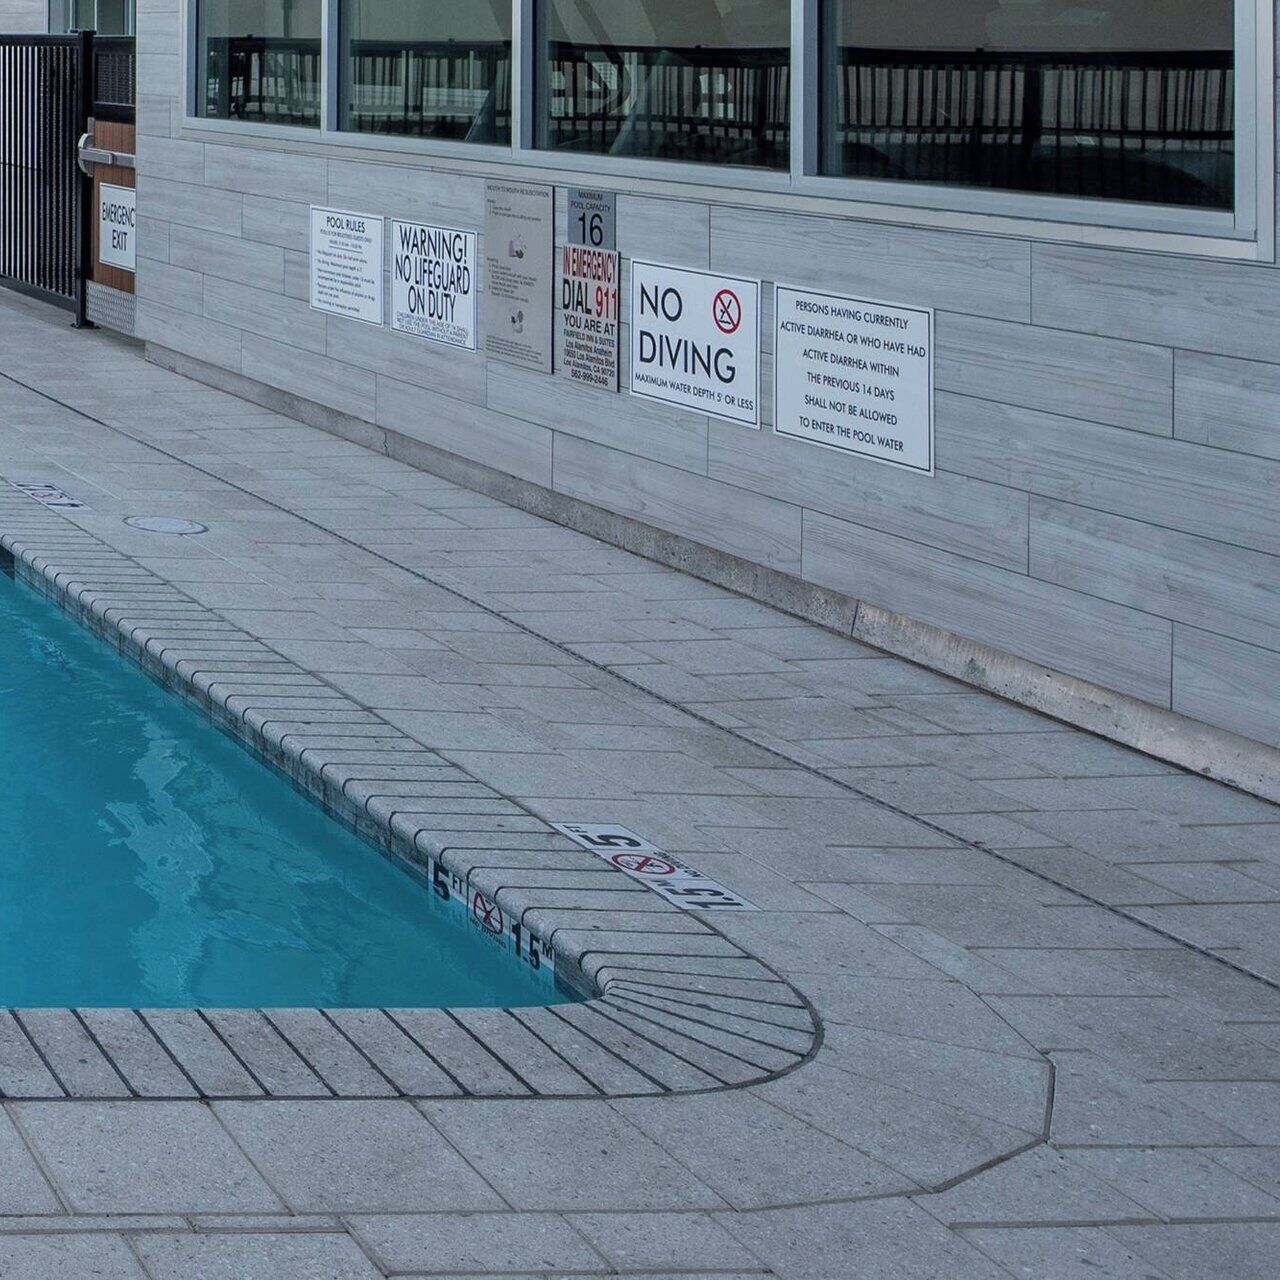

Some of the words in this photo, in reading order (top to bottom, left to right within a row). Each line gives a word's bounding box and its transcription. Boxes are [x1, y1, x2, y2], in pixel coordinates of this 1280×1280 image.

[571, 200, 585, 210] POOL
[586, 202, 611, 212] CAPACITY
[578, 191, 603, 200] MAXIMUM
[102, 202, 135, 227] EMERGENC
[326, 216, 344, 229] POOL
[346, 219, 365, 233] RULES
[578, 212, 603, 246] 16
[112, 229, 127, 251] EXIT
[399, 224, 467, 264] WARNING!
[395, 253, 412, 283] NO
[415, 256, 471, 295] LIFEGUARD
[563, 245, 571, 276] IN
[572, 248, 617, 284] EMERGENCY
[408, 285, 425, 315] ON
[428, 289, 456, 323] DUTY
[562, 277, 592, 315] DIAL
[595, 286, 617, 321] 911
[640, 282, 683, 322] NO
[795, 300, 829, 316] PERSONS
[831, 307, 862, 321] HAVING
[863, 312, 909, 330] CURRENTLY
[563, 313, 582, 329] YOU
[583, 319, 602, 333] ARE
[603, 322, 616, 336] AT
[563, 328, 585, 340] FAIRFIELD
[586, 333, 594, 342] INN
[599, 337, 615, 348] SUITES
[780, 320, 806, 335] ACTIVE
[807, 325, 845, 343] DIARRHEA
[846, 333, 858, 344] OR
[860, 335, 881, 349] WHO
[883, 340, 905, 354] HAVE
[907, 345, 926, 358] HAD
[639, 329, 736, 384] DIVING
[802, 348, 828, 363] ACTIVE
[830, 353, 868, 370] DIARRHEA
[870, 361, 900, 377] WITHIN
[635, 372, 669, 389] MAXIMUM
[669, 380, 691, 393] WATER
[692, 386, 715, 401] DEPTH
[725, 394, 736, 406] OR
[737, 397, 754, 411] LESS
[807, 371, 821, 384] THE
[823, 375, 860, 393] PREVIOUS
[862, 384, 872, 396] 14
[874, 387, 895, 401] DAYS
[804, 394, 827, 409] SHALL
[829, 400, 846, 413] NOT
[848, 404, 858, 416] BE
[859, 408, 898, 426] ALLOWED
[799, 416, 810, 428] TO
[811, 419, 834, 434] ENTER
[836, 426, 851, 439] THE
[853, 430, 875, 445] POOL
[877, 436, 904, 452] WATER
[432, 860, 450, 902] 5
[452, 872, 463, 894] FT
[481, 926, 507, 949] DIVING
[511, 922, 540, 970] 1.5
